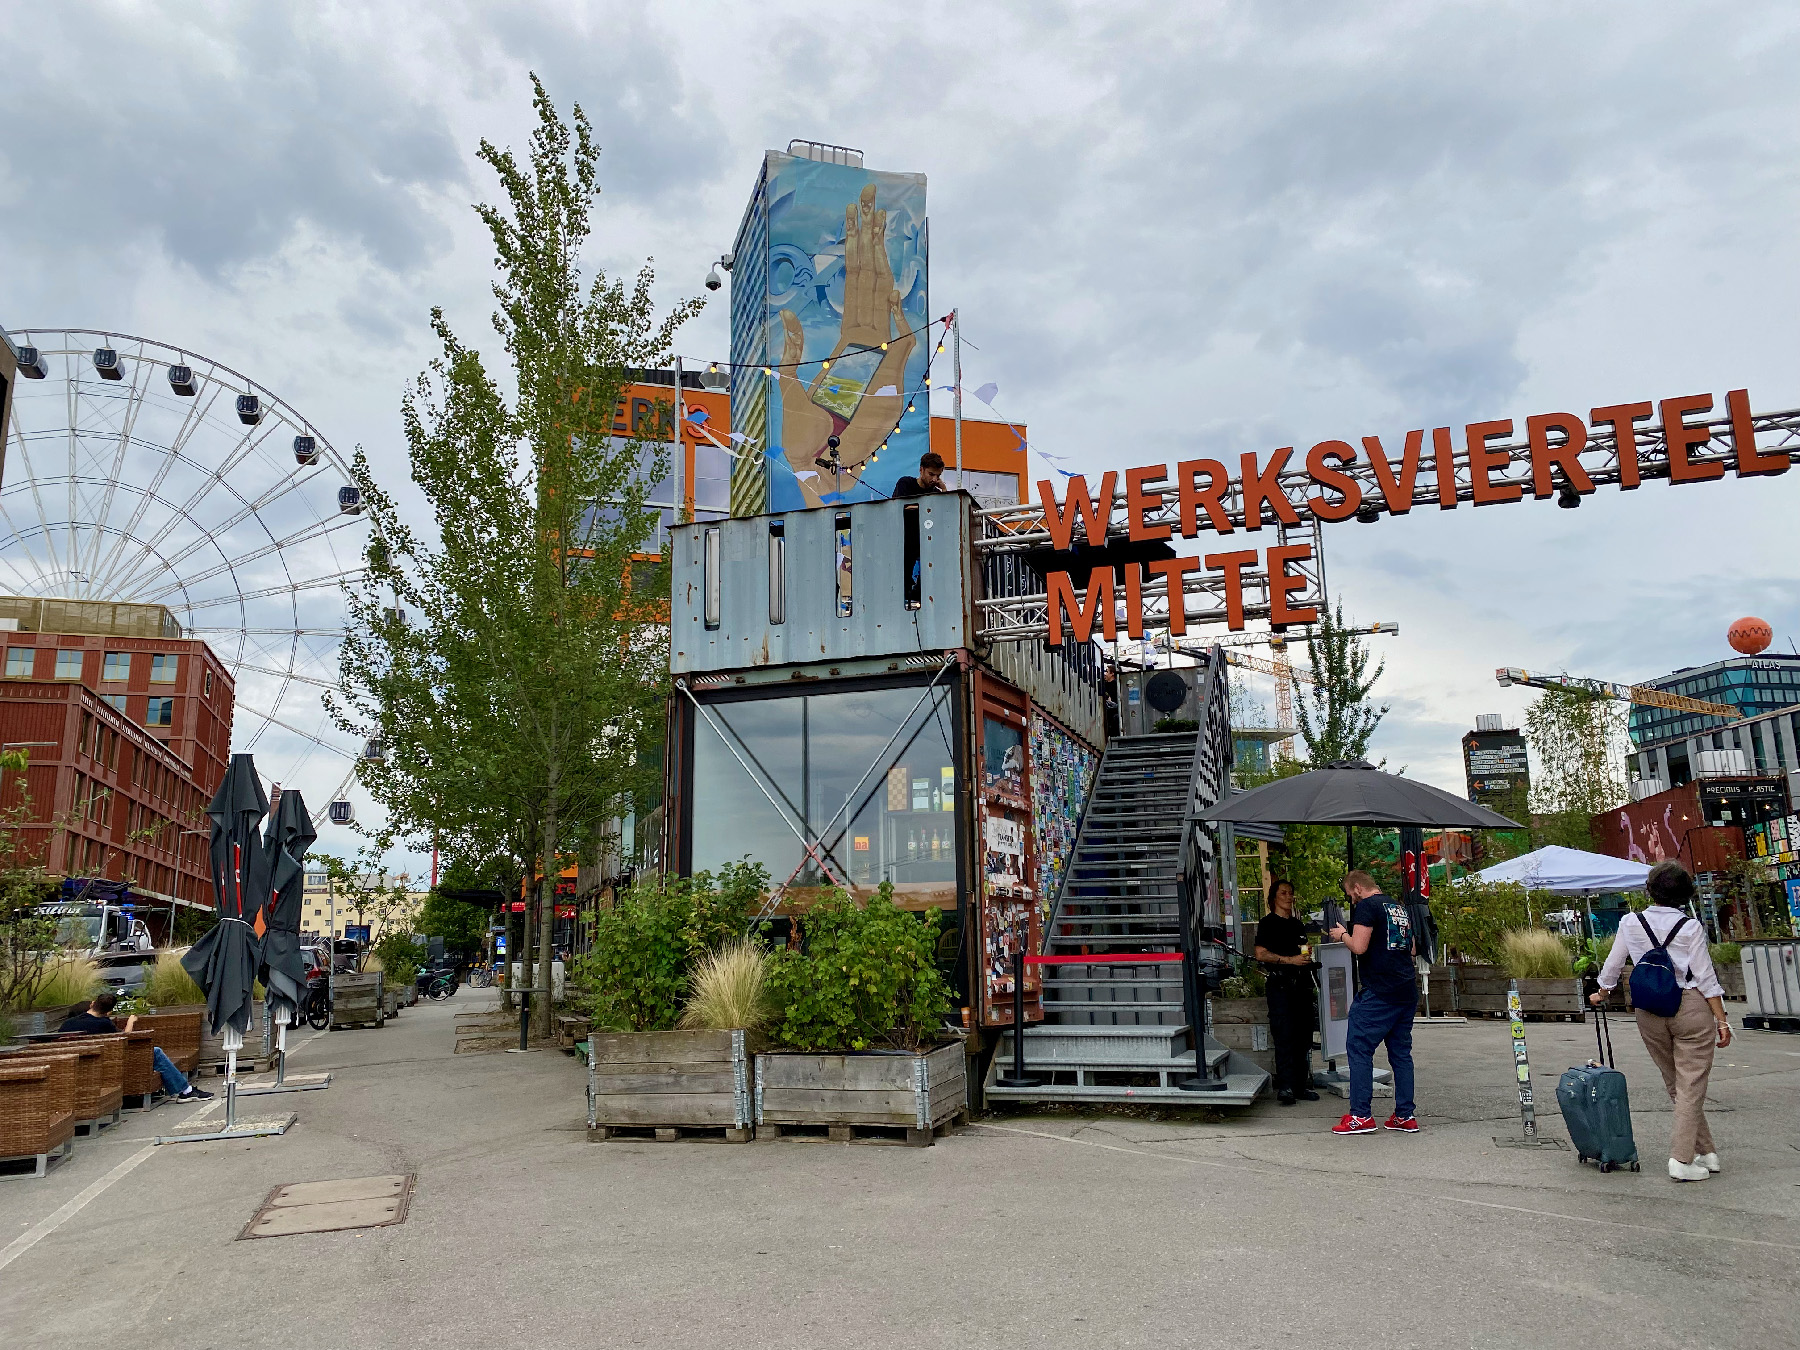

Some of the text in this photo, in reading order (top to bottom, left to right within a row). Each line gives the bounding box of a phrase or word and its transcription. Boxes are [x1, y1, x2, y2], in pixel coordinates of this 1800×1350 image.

[594, 395, 710, 439] ERK3
[1037, 389, 1790, 551] WERKSVIERTEL
[1046, 543, 1317, 646] MITTE
[1752, 660, 1780, 669] ATLAS
